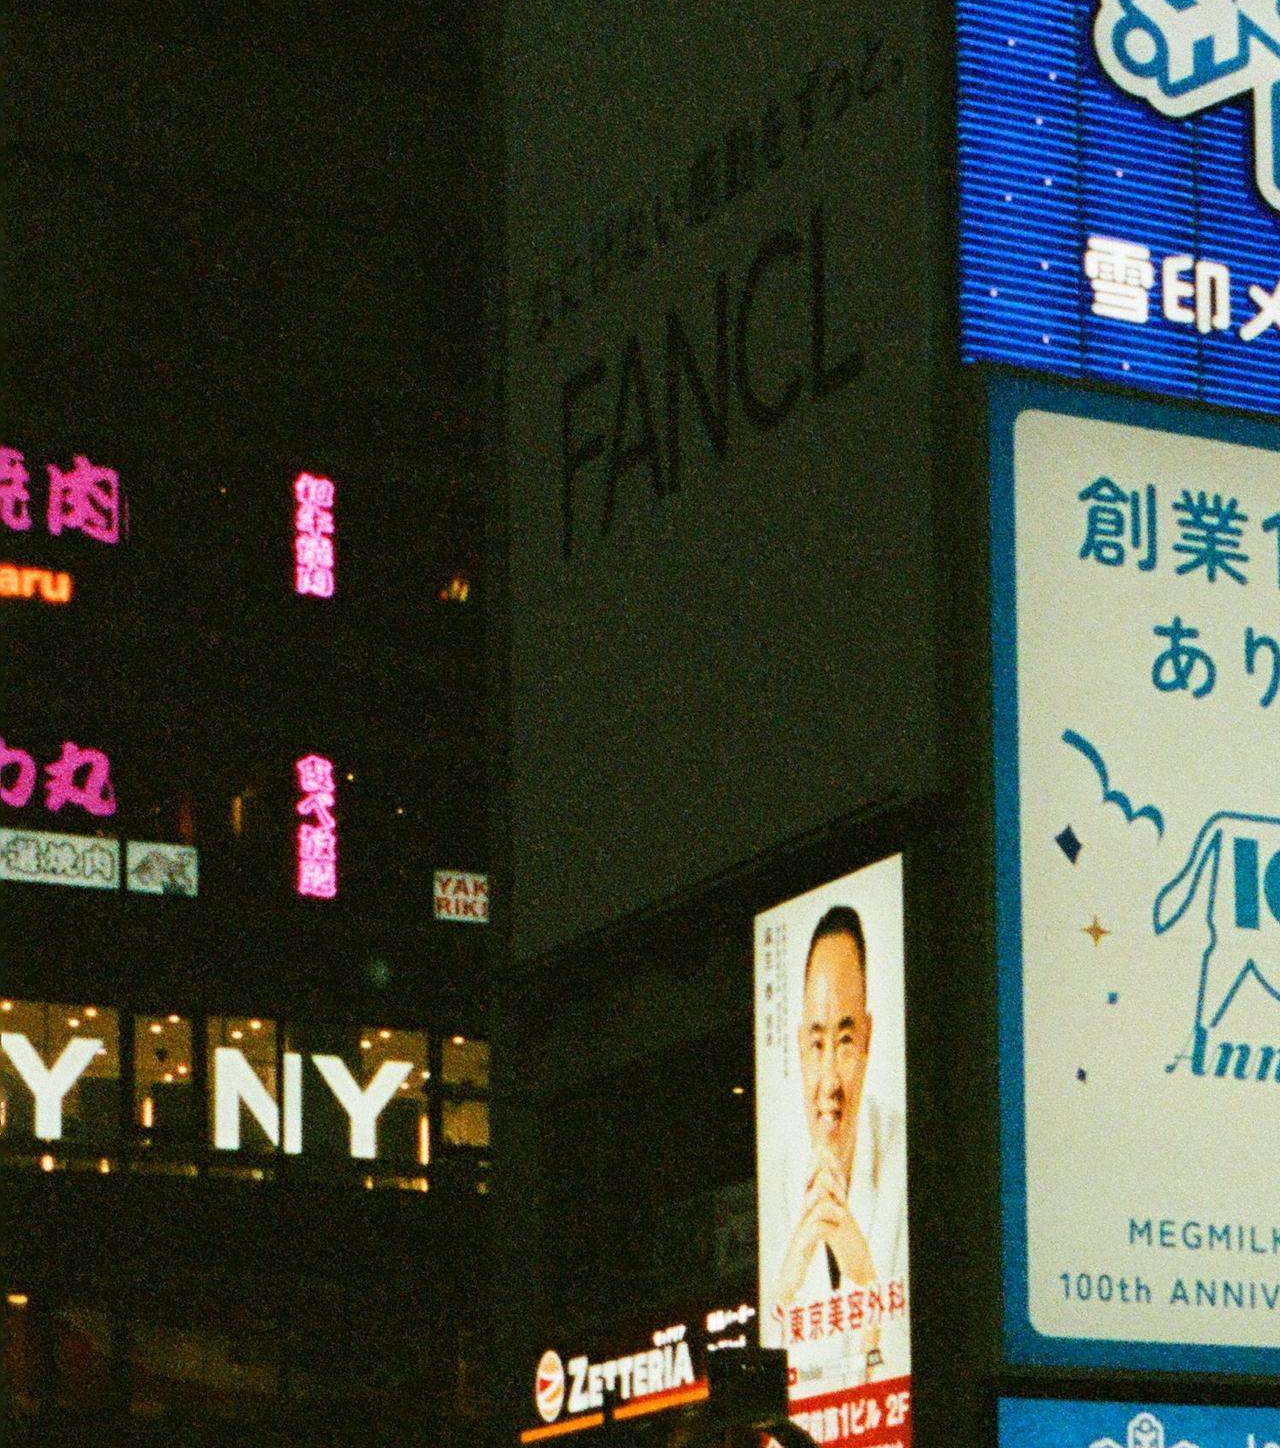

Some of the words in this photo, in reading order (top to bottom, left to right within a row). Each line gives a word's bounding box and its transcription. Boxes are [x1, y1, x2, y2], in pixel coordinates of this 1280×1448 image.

[563, 200, 865, 559] FANCL
[214, 1046, 415, 1160] NY
[1059, 1272, 1152, 1305] 100th
[567, 1341, 696, 1414] ZETTERIA
